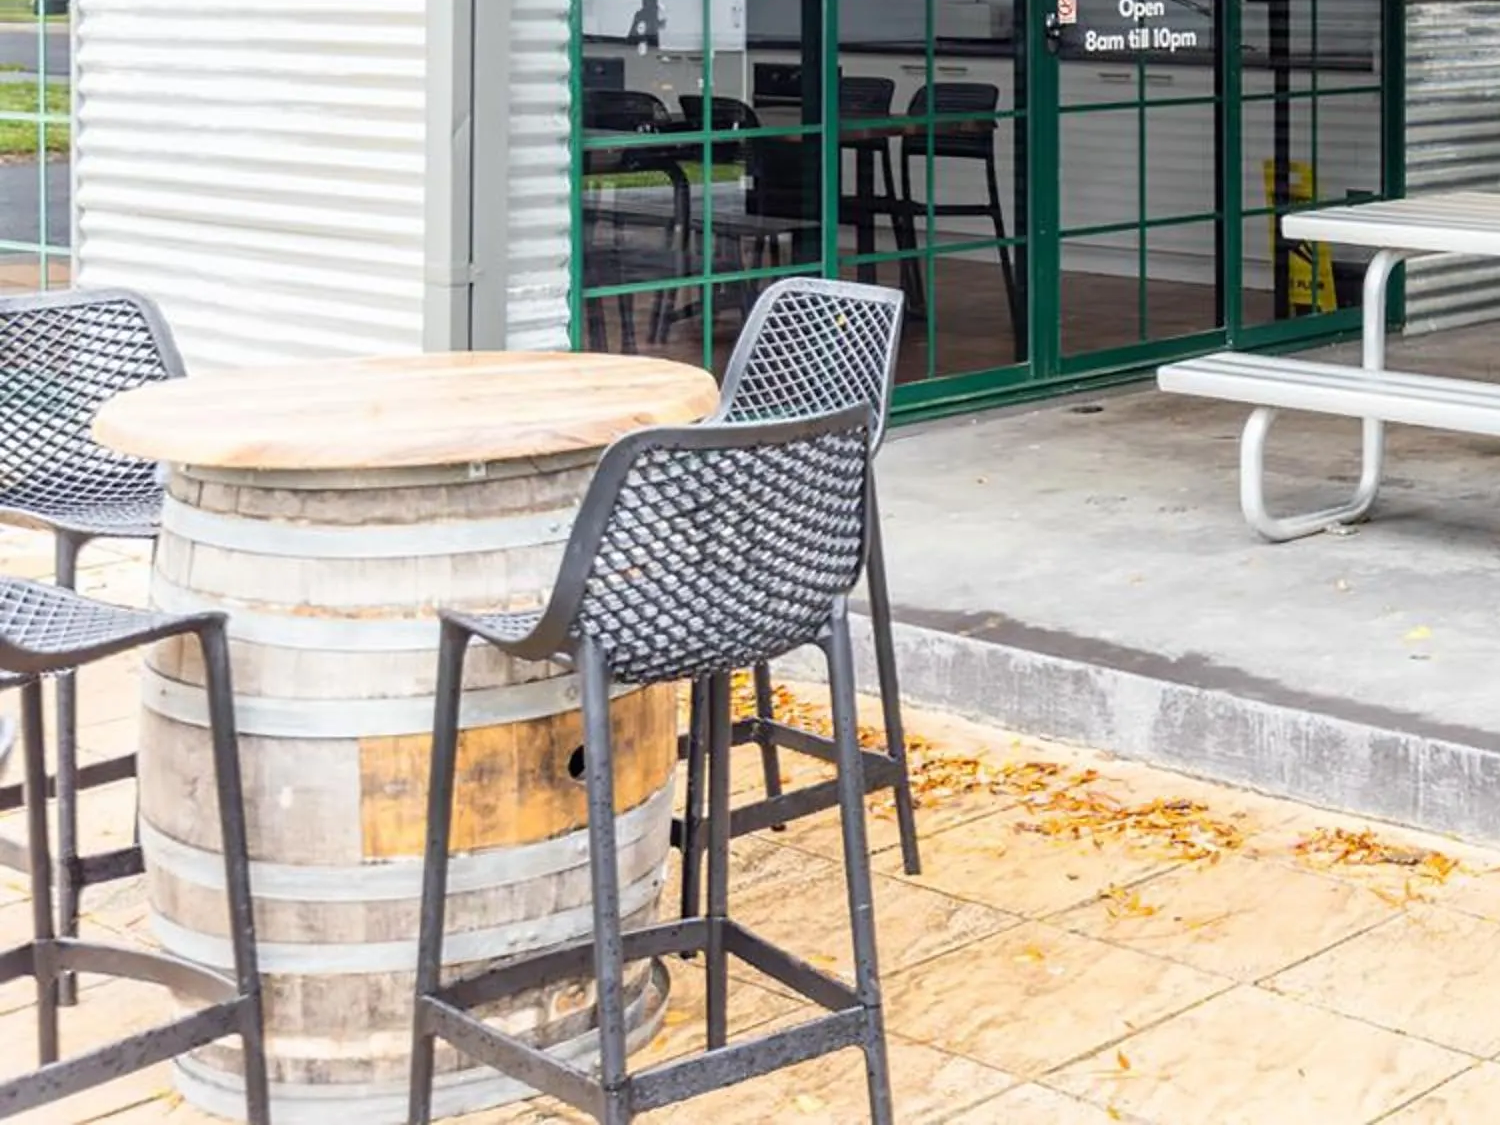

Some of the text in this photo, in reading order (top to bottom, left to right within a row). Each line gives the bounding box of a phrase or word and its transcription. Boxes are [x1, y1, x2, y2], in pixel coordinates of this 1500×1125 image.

[1085, 27, 1197, 52] 8am till 10pm
